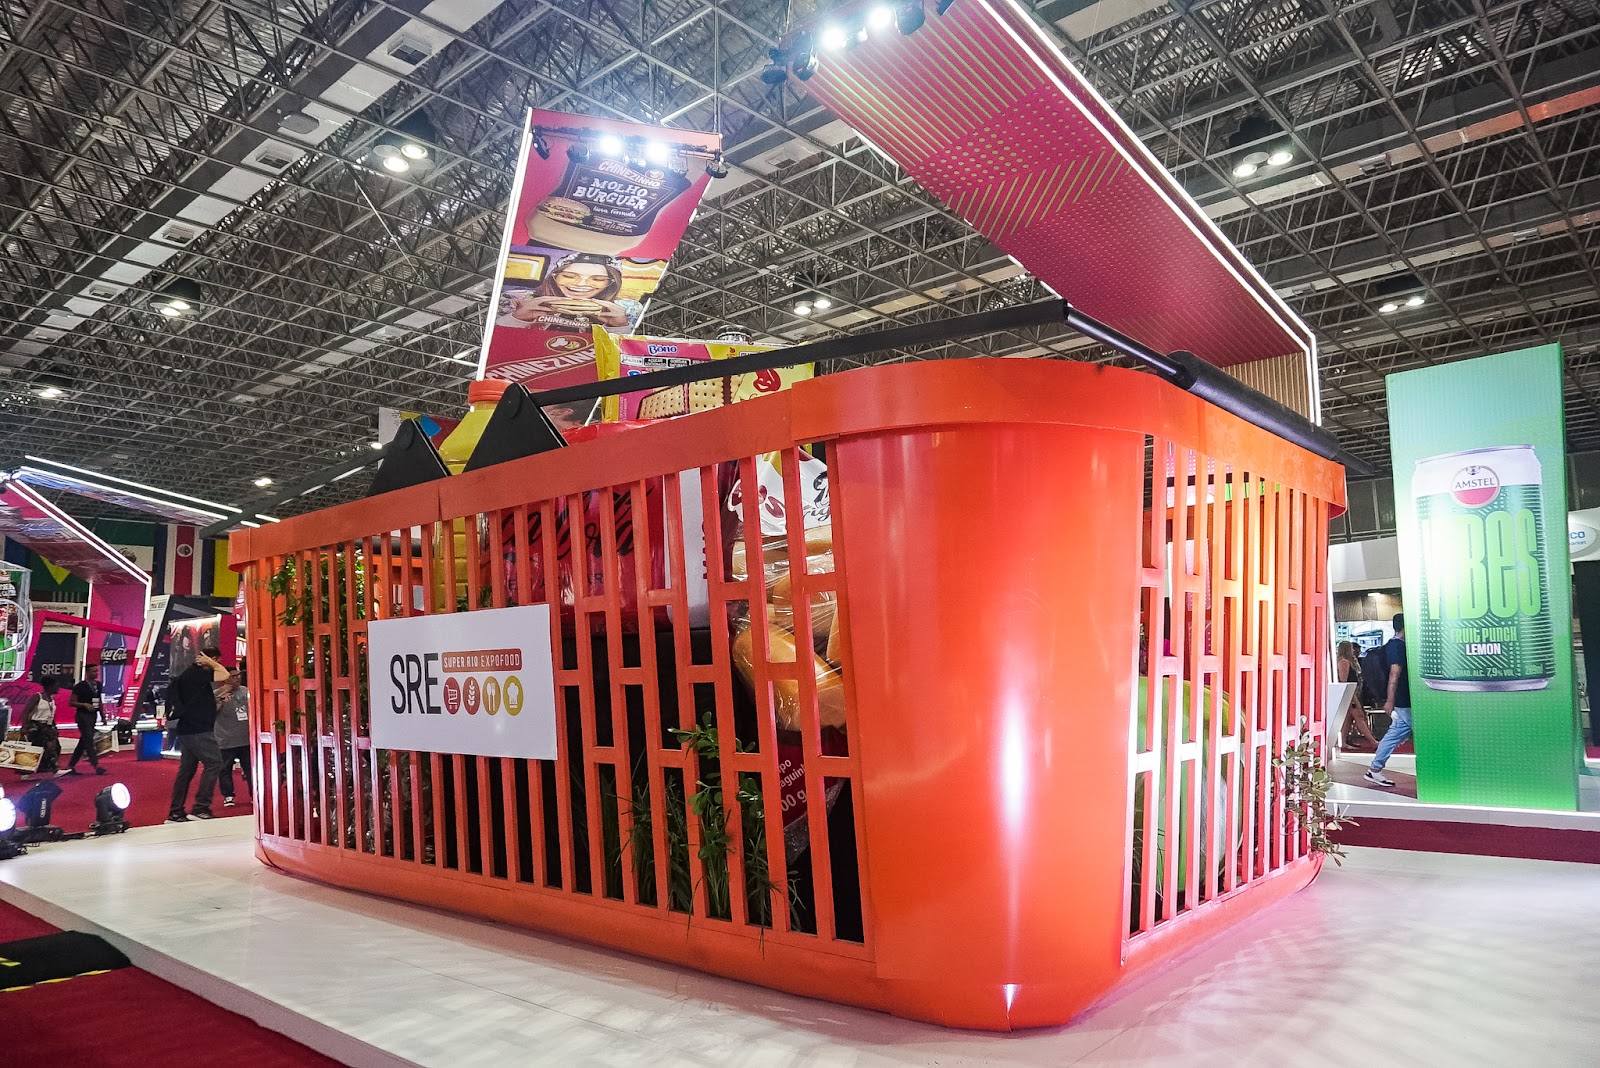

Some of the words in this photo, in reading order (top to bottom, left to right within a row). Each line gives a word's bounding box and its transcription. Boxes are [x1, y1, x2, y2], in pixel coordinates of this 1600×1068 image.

[599, 160, 661, 187] CHINEZINHO
[591, 178, 648, 197] MOLHO
[573, 185, 648, 210] BURGUER
[538, 316, 590, 328] CHINEZINHO
[648, 344, 678, 355] Bono
[485, 347, 597, 382] CHINEZINH
[1454, 477, 1495, 489] AMSTEL
[1465, 643, 1501, 655] LEMON
[41, 663, 61, 675] SRE
[390, 653, 441, 714] SRE
[443, 657, 465, 668] SUPER
[466, 656, 478, 668] RIO
[481, 653, 520, 668] EXPOFOOD
[779, 759, 792, 774] po
[781, 793, 797, 812] 00
